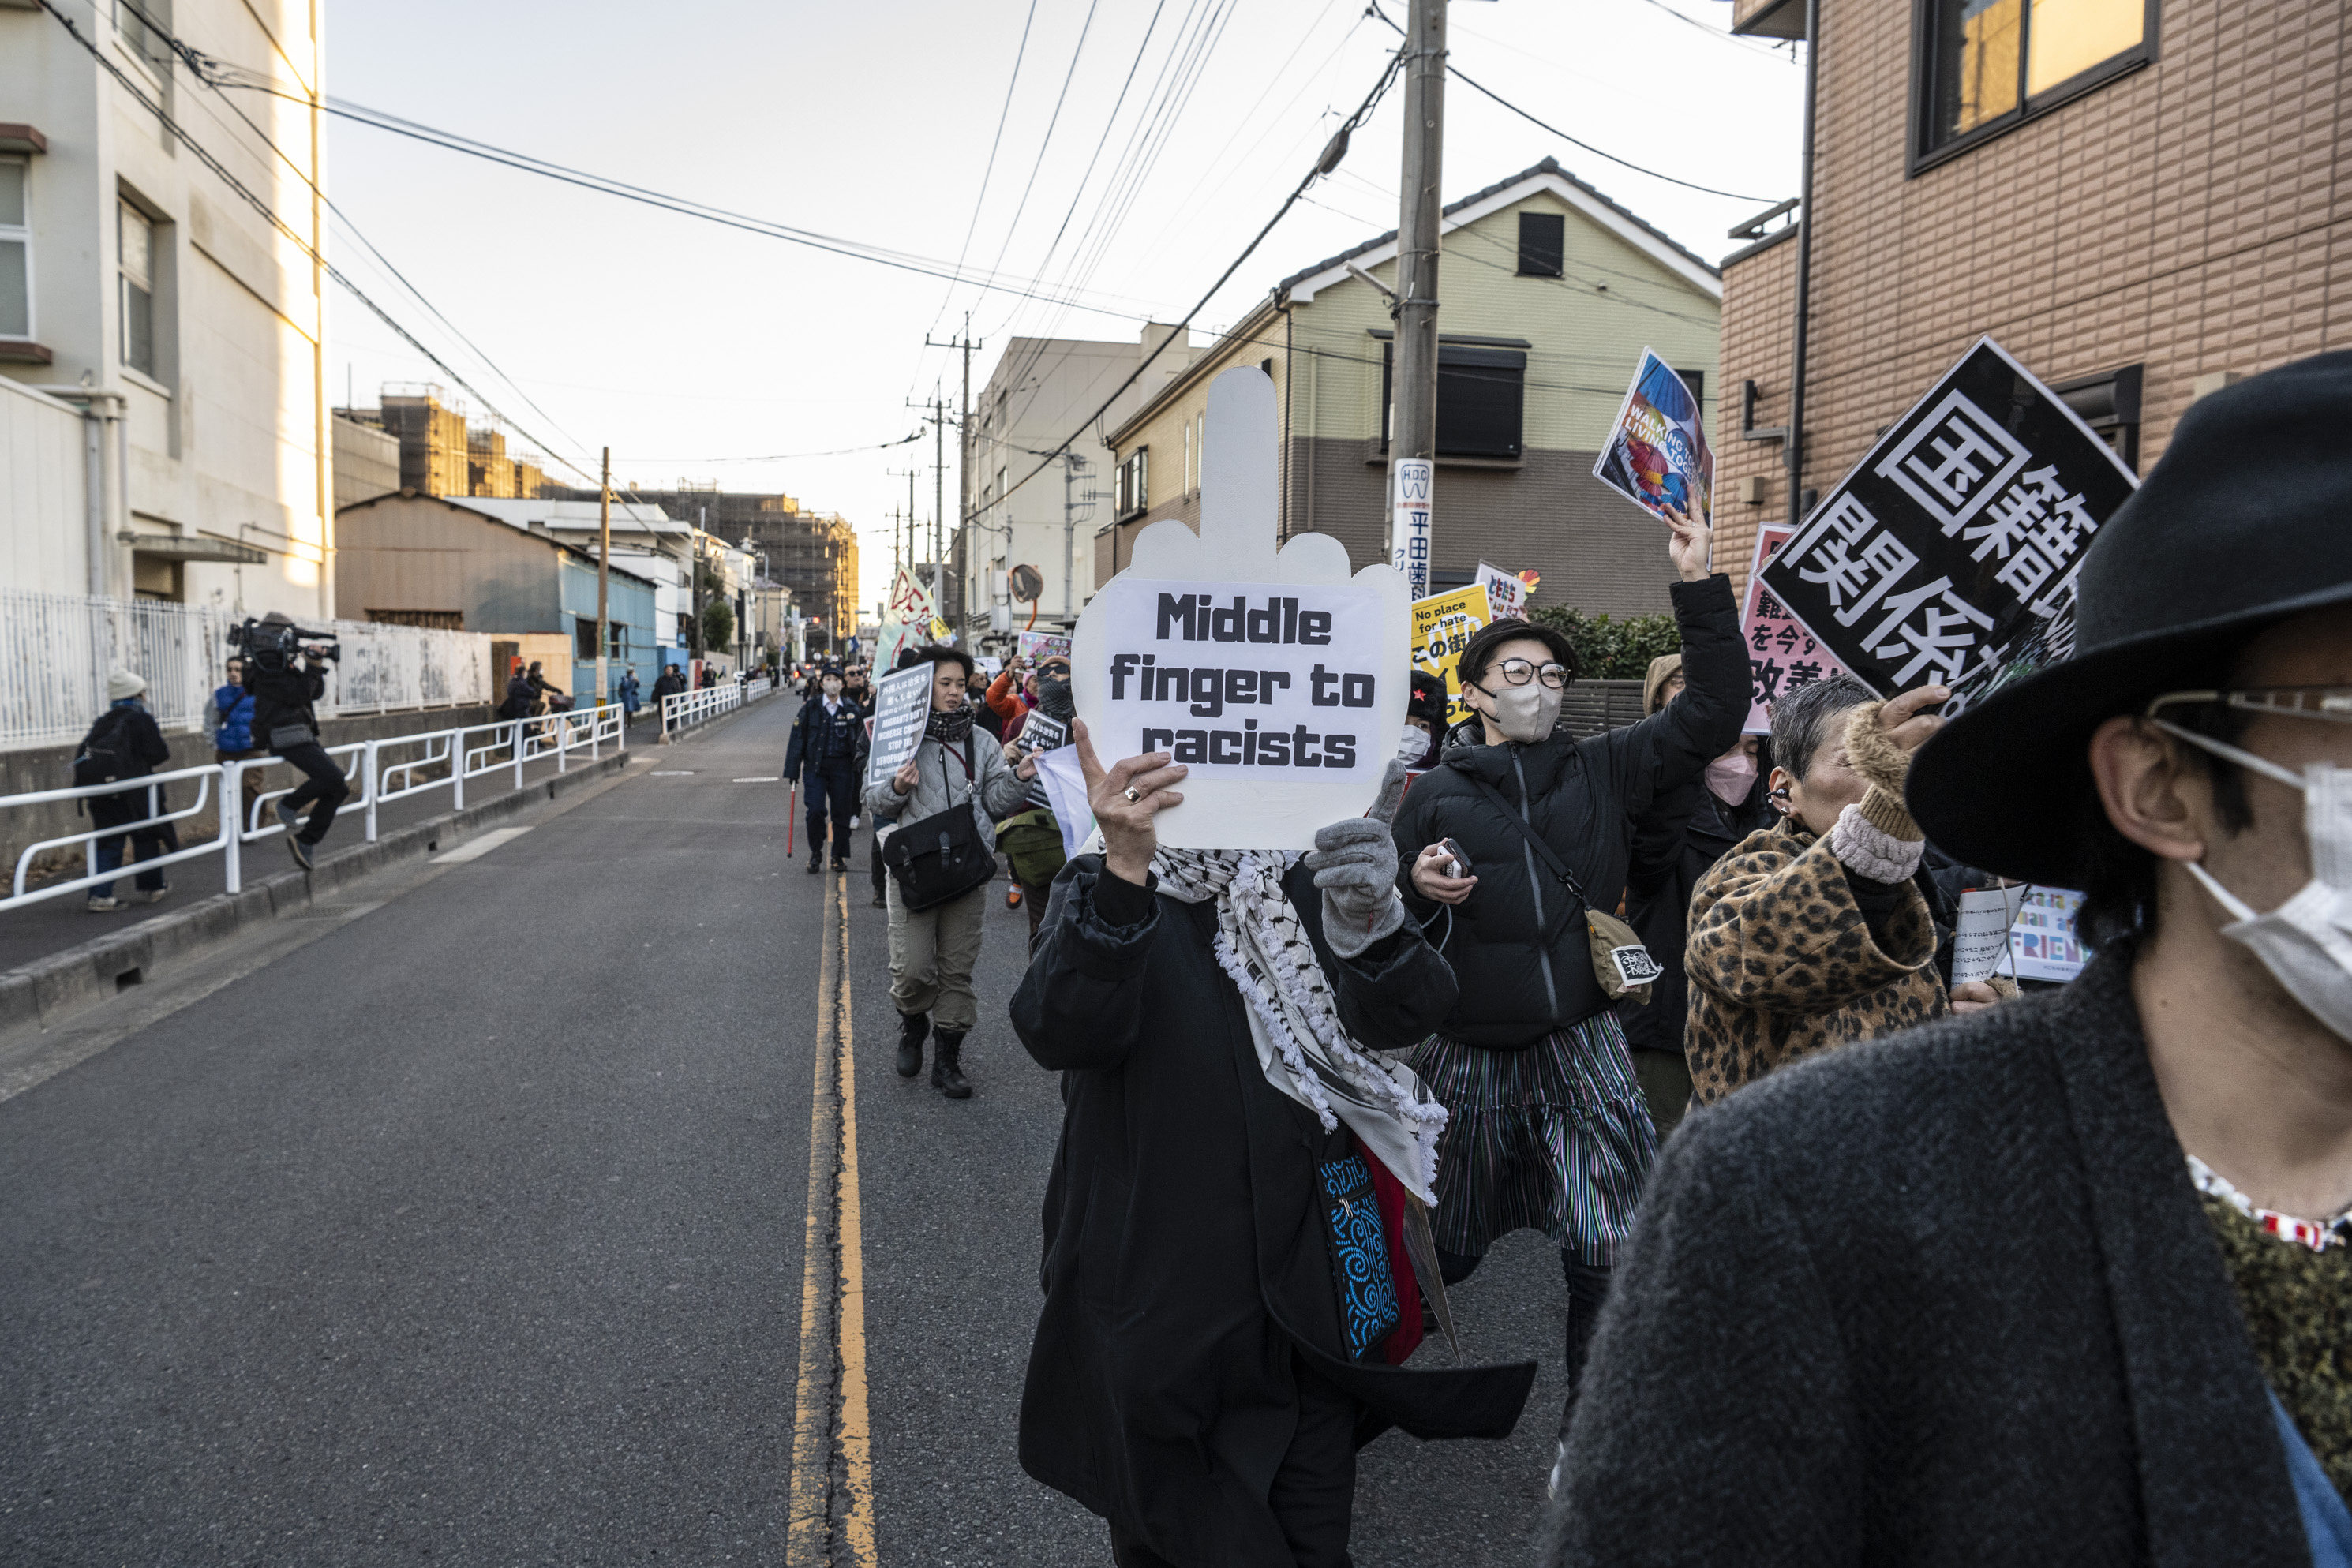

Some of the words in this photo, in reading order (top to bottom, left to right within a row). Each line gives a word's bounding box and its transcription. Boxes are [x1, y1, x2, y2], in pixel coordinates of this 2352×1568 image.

[1624, 417, 1668, 453] LIVING
[1630, 403, 1683, 452] WALKING
[1415, 609, 1432, 622] No
[1434, 601, 1466, 619] place
[1756, 589, 1793, 620] 難
[1156, 592, 1332, 646] Middle
[1418, 622, 1436, 634] for
[1439, 614, 1467, 629] hate
[1110, 653, 1291, 717] finger
[1310, 664, 1376, 708] to
[882, 712, 910, 728] MIGRANTS
[877, 727, 903, 742] INCREASE
[888, 739, 903, 751] STOP
[904, 736, 913, 748] THE
[1142, 718, 1356, 769] racists
[875, 750, 910, 767] XENOPHOBIC
